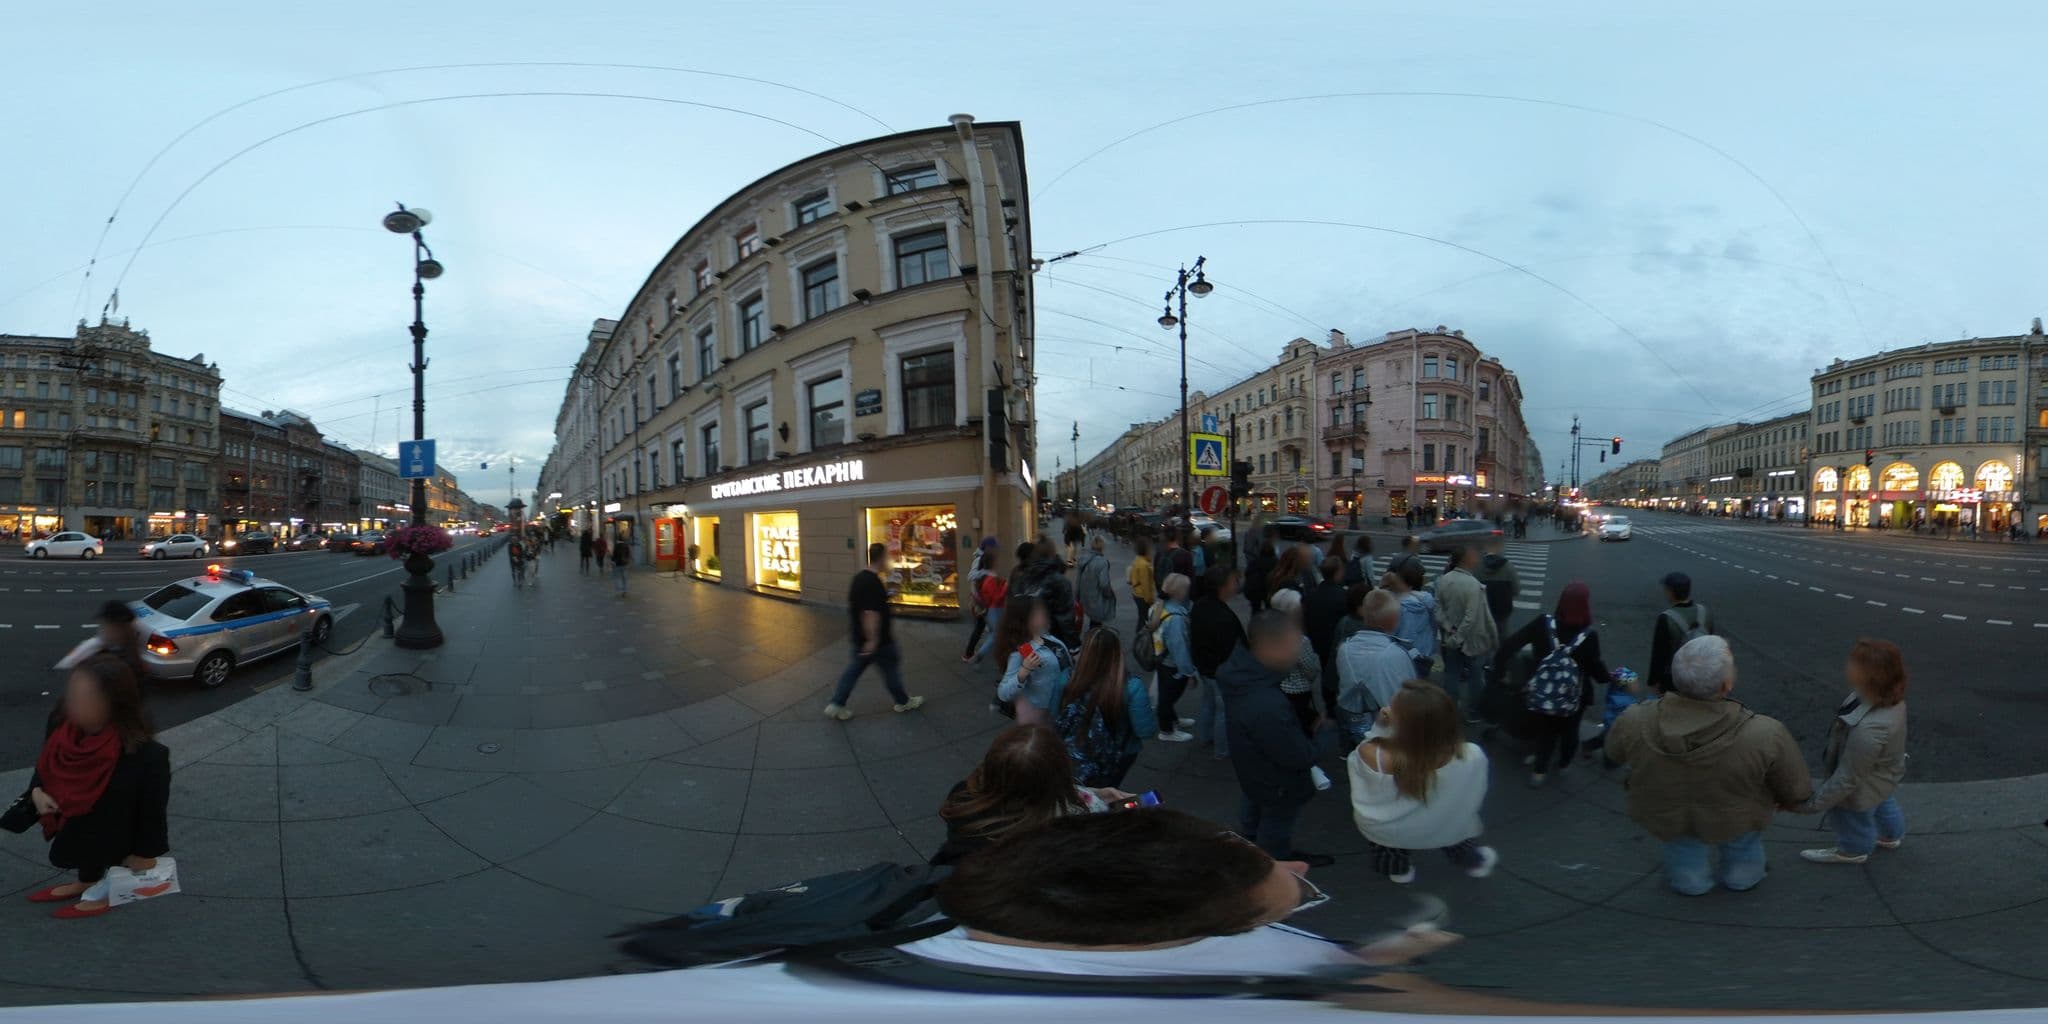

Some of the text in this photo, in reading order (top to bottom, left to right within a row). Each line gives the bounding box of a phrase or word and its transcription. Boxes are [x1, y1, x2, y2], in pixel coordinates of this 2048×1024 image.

[711, 460, 864, 499] БРИТАНСКИЕ ПЕКАРНИ
[761, 526, 799, 540] TAKE
[761, 540, 799, 559] EAT
[762, 557, 800, 574] EASY
